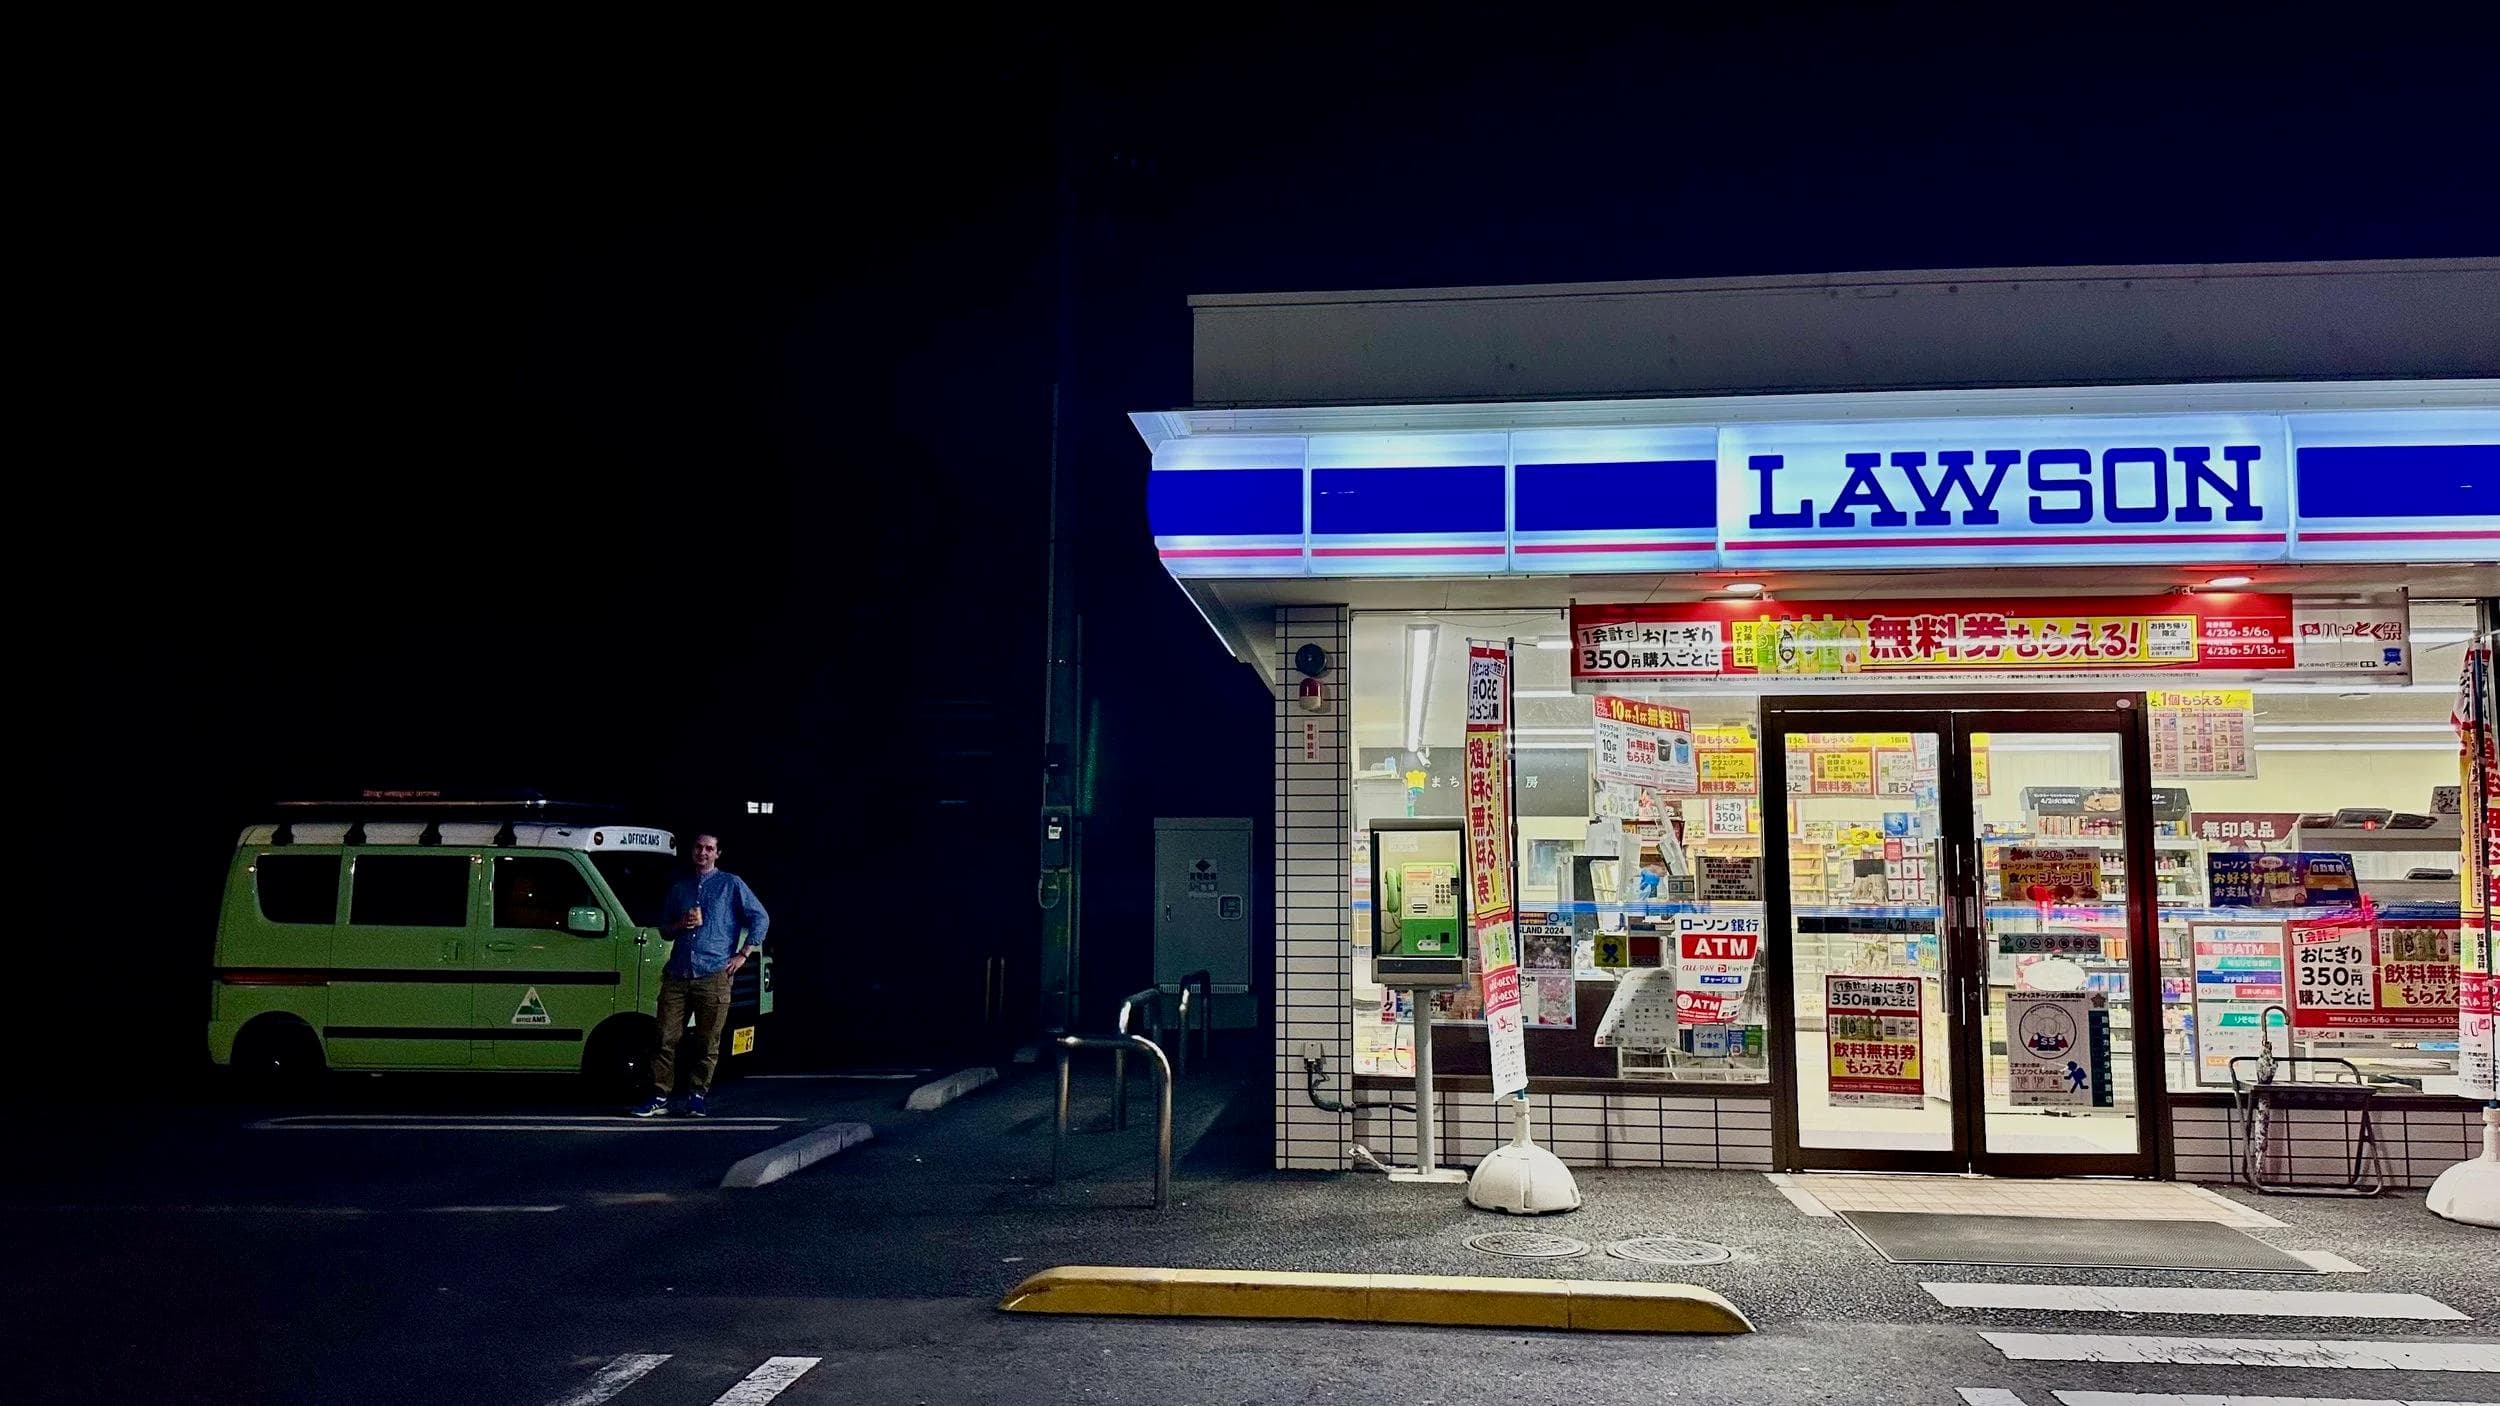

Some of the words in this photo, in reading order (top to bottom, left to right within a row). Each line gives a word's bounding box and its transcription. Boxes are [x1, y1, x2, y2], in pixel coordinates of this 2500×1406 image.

[1748, 446, 2263, 529] LAWSON
[1642, 626, 1714, 648] おにぎり
[1715, 803, 1741, 812] おにぎり
[2201, 820, 2275, 839] 無印良品
[628, 833, 648, 845] OFFICE
[2213, 872, 2300, 885] お好きな時間に
[2214, 886, 2266, 898] お支払い!
[1545, 926, 1565, 935] 2024
[1680, 918, 1759, 932] ローソン銀行
[1694, 938, 1749, 957] ATM
[2300, 946, 2363, 965] おにぎり
[1682, 963, 1697, 972] au
[1699, 964, 1715, 972] PAY
[2301, 966, 2363, 987] 350円
[1871, 982, 1915, 994] おにぎり
[1692, 999, 1719, 1010] ATM
[2299, 988, 2371, 1006] 購入ごとに
[1833, 1041, 1916, 1060] 飲料無料券
[1846, 1059, 1905, 1076] もらえる!
